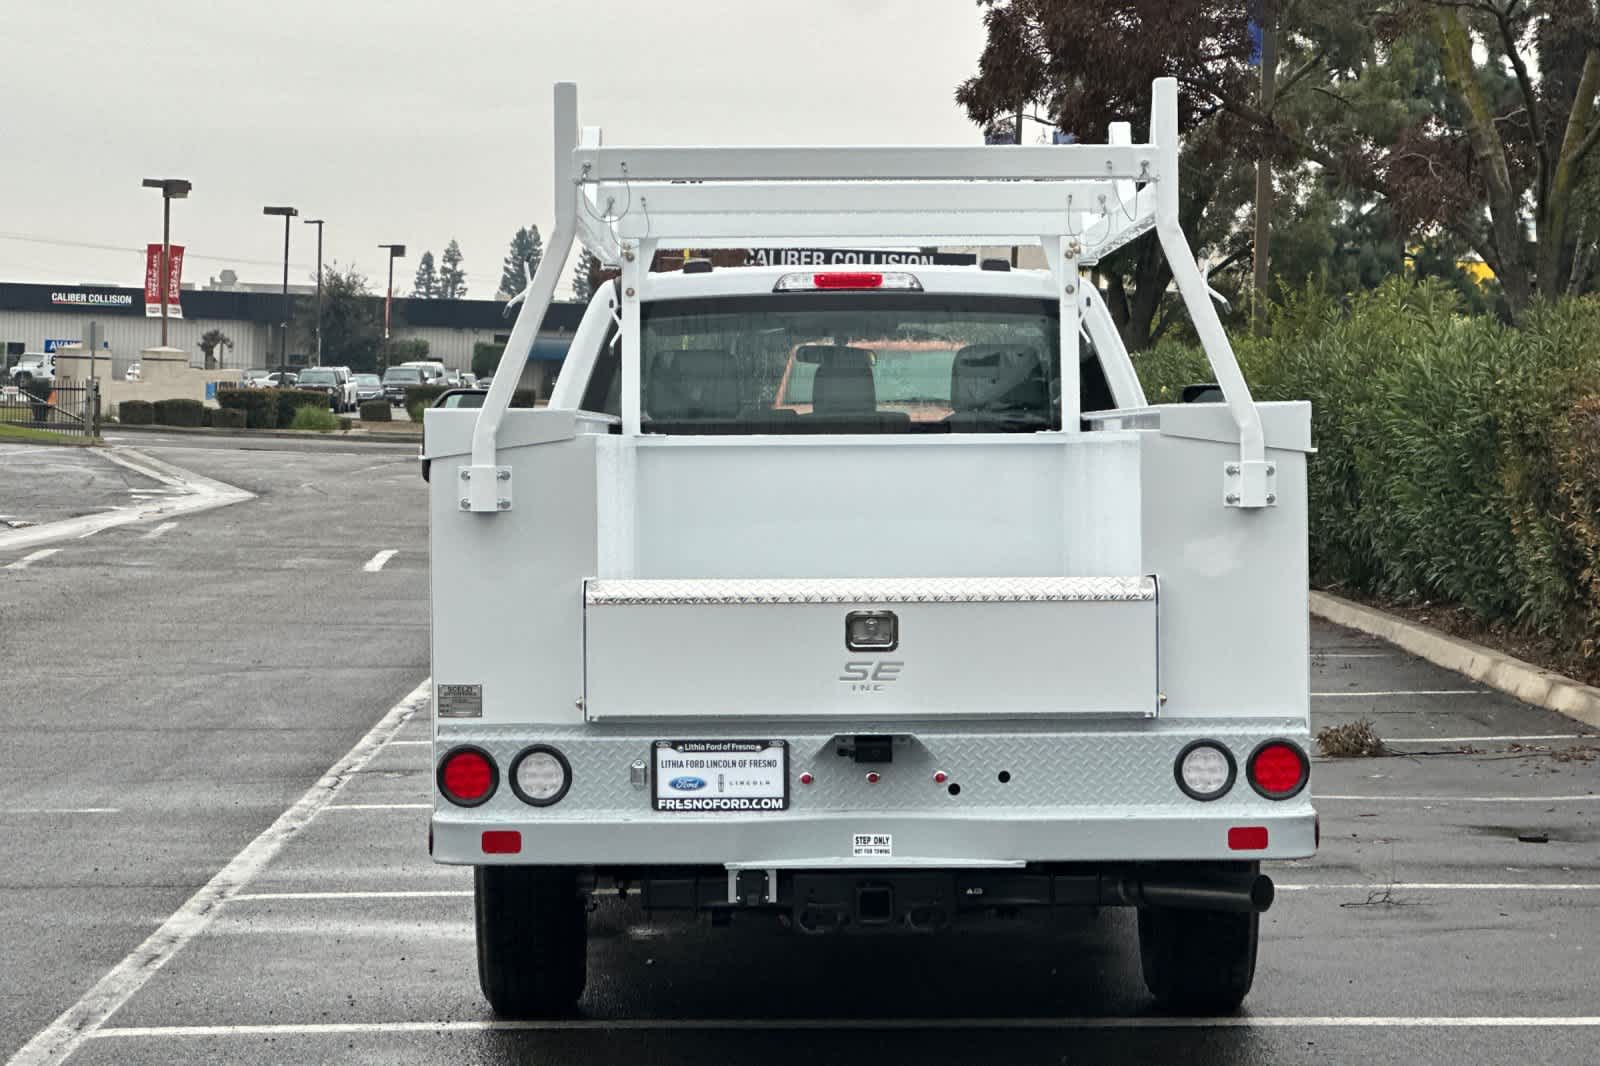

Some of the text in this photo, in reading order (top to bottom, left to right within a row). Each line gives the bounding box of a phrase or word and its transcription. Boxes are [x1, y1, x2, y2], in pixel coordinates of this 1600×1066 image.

[744, 250, 935, 266] CALIBER COLLISION
[51, 292, 132, 304] CALIBER COLLISION
[684, 743, 755, 751] Lithia Ford of Fresno
[660, 759, 778, 769] LITHIA FORD LINCOLN OF FRESNO
[658, 798, 784, 810] FRESNOFORD.COM
[855, 836, 890, 845] STEP ONLY
